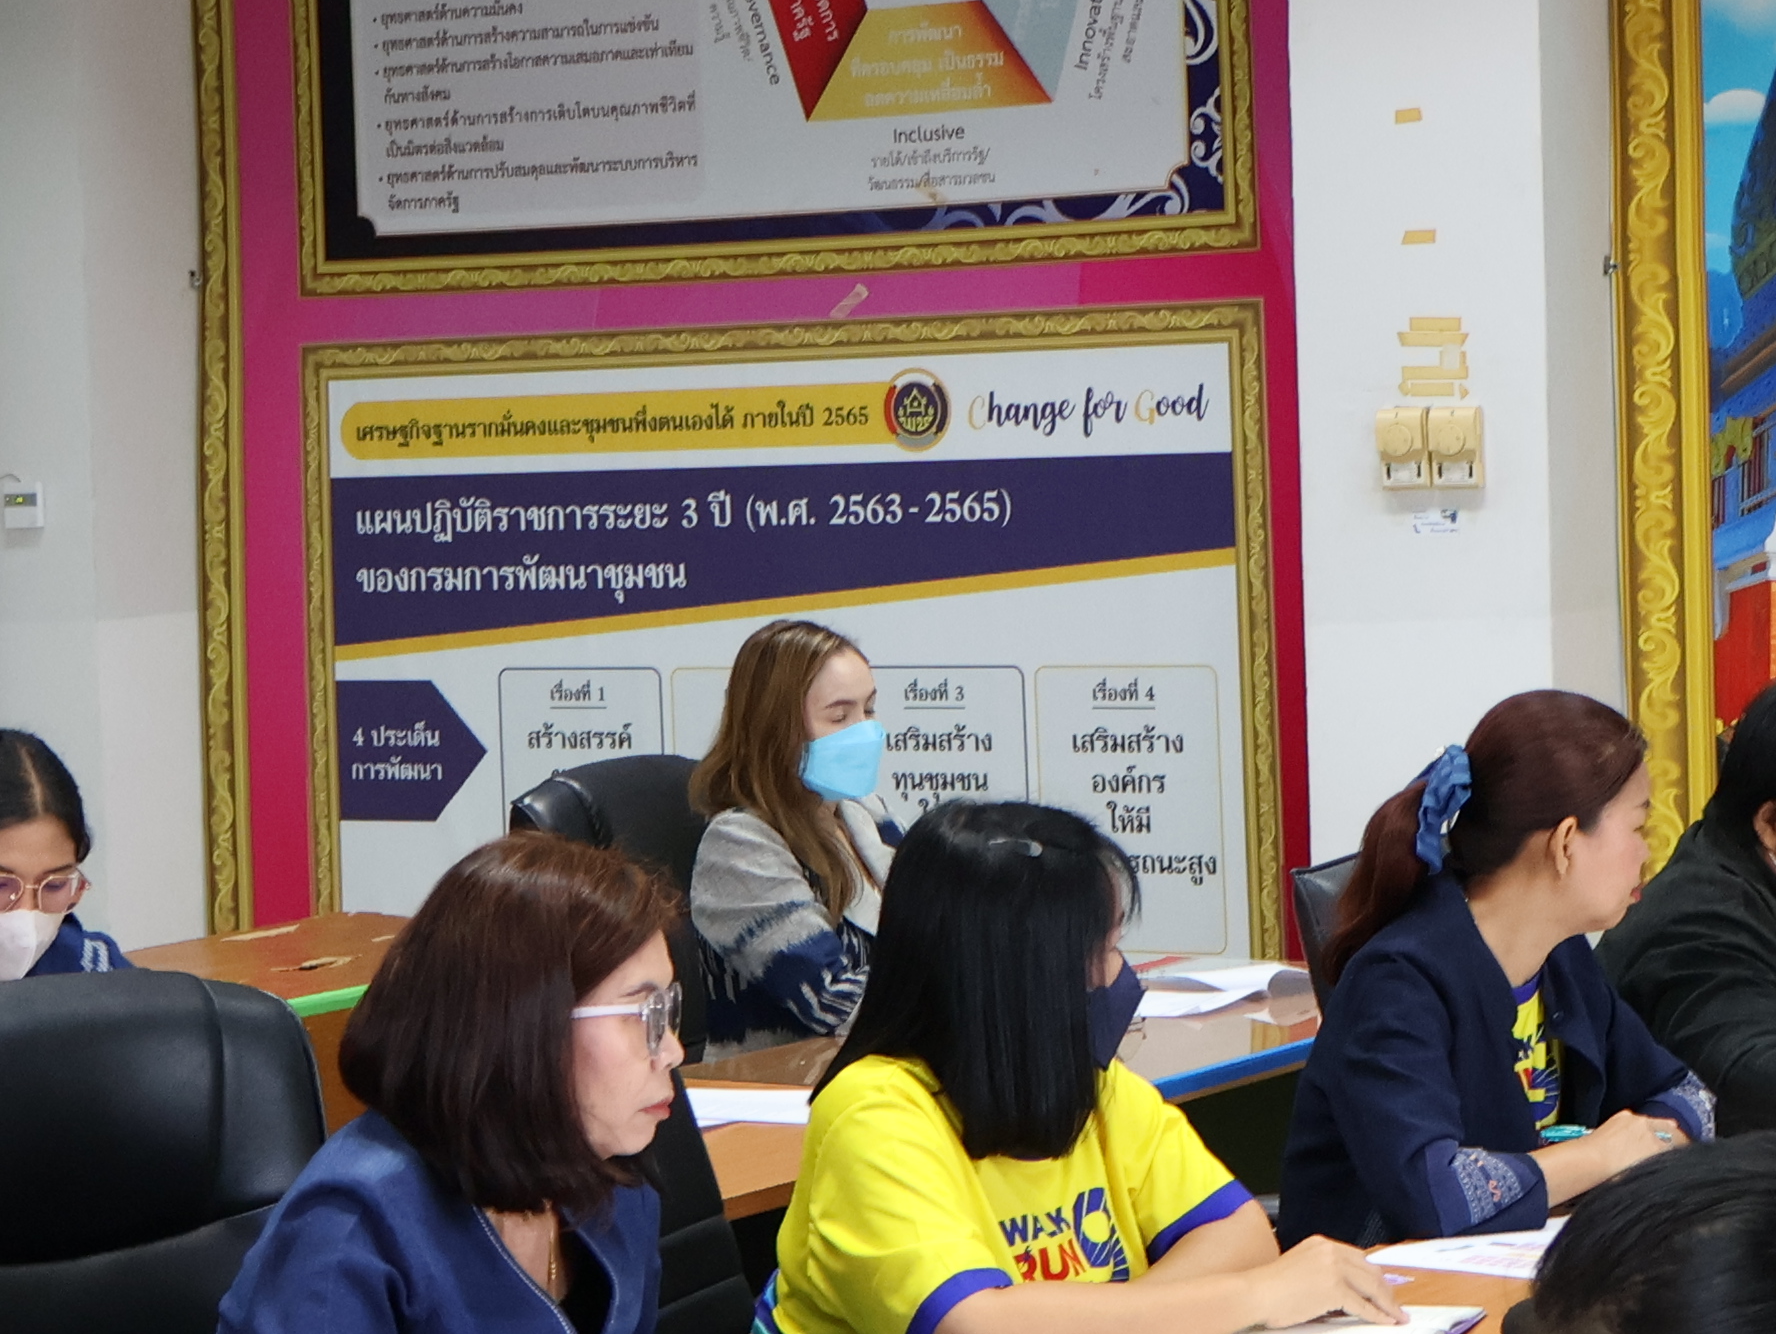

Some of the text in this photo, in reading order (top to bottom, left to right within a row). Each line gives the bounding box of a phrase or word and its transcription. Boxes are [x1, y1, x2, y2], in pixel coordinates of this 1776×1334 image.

[893, 124, 965, 144] Inclusive
[355, 400, 870, 448] เศรษฐกิจฐานรากมั่นคงและชุมชนพึ่งตนเองได้ ภายในปี 2565
[968, 383, 1211, 439] Change for Good
[355, 495, 669, 542] แผนปฏิบัติราชการระยะ
[680, 497, 698, 530] 3
[708, 489, 732, 529] ปี
[745, 492, 817, 533] (พ.ศ.
[355, 555, 687, 603] ของกรมการพัฒนาชุมชน
[550, 679, 606, 703] เรื่องที่ 1
[904, 677, 965, 702] เรื่องที่ 3
[1092, 677, 1156, 702] เรื่องที่ 4
[352, 721, 441, 748] 4 ประเด็น
[527, 722, 632, 750] สร้างสรรค์
[886, 724, 992, 752] เสริมสร้าง
[1072, 723, 1184, 754] เสริมสร้าง
[352, 755, 443, 781] การพัฒนา
[1091, 764, 1166, 794] องค์กร
[892, 771, 989, 802] ทุนชุมชน
[1106, 800, 1151, 834] ให้มี
[1131, 852, 1217, 886] รถนะสูง
[1013, 1238, 1087, 1282] RUN
